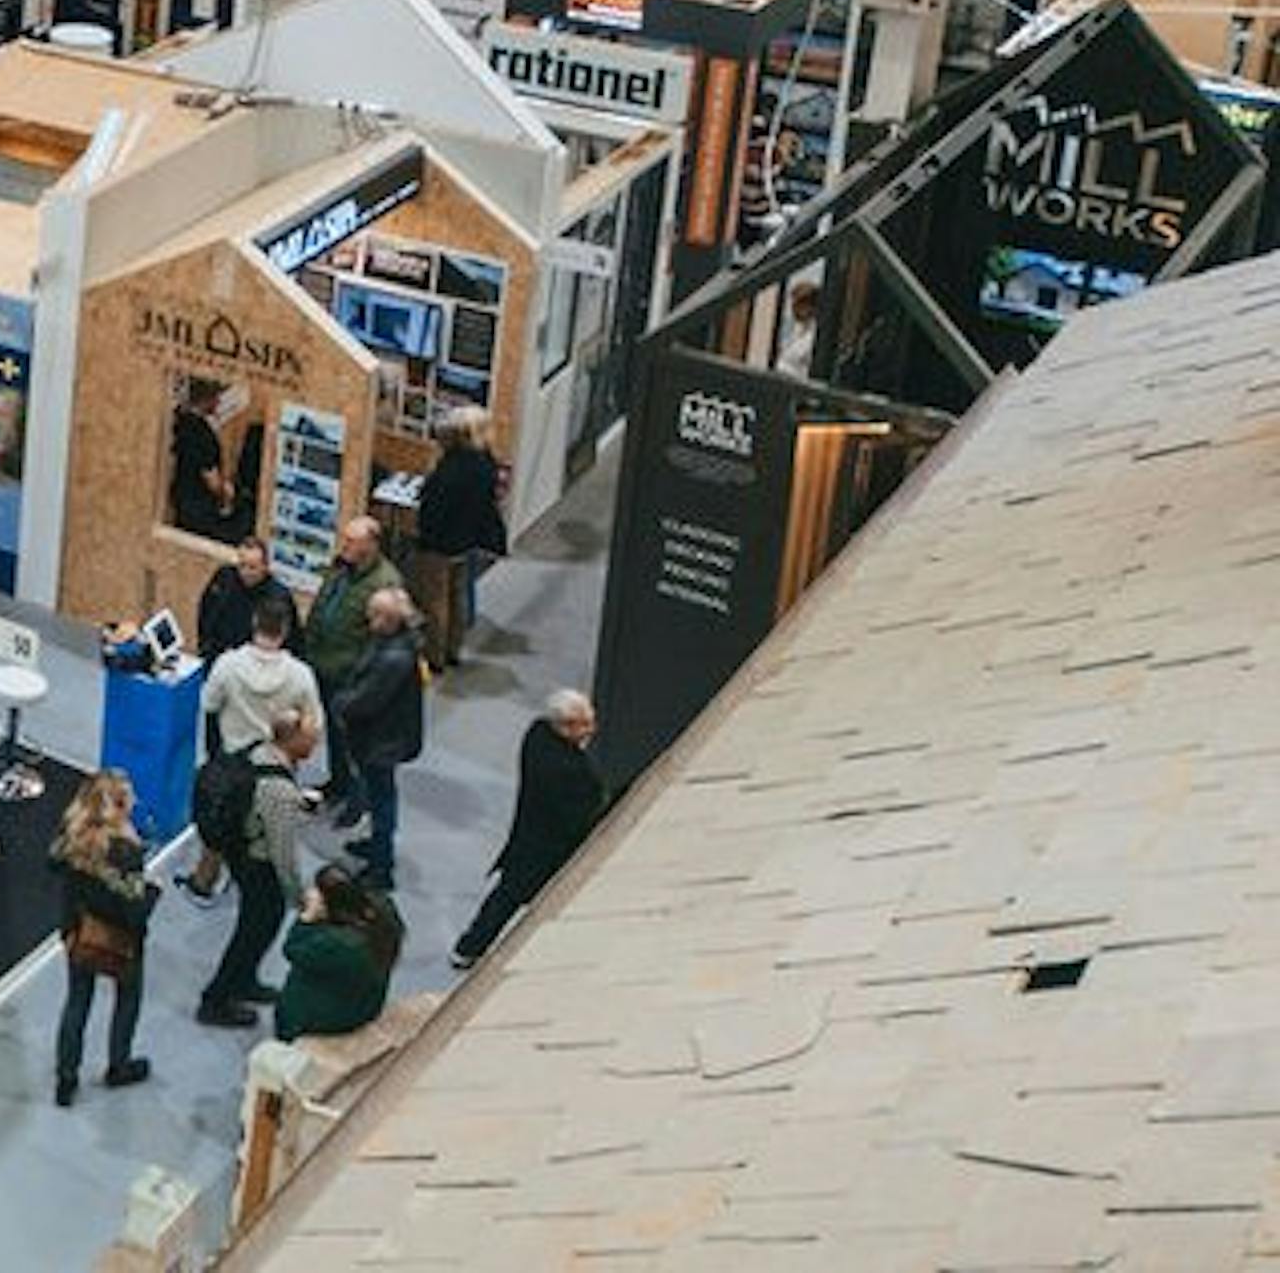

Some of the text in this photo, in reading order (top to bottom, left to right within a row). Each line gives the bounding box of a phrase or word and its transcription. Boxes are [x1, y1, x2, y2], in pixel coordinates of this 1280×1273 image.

[489, 43, 666, 108] rationel
[984, 116, 1187, 213] MILL
[982, 176, 1182, 248] WORKS
